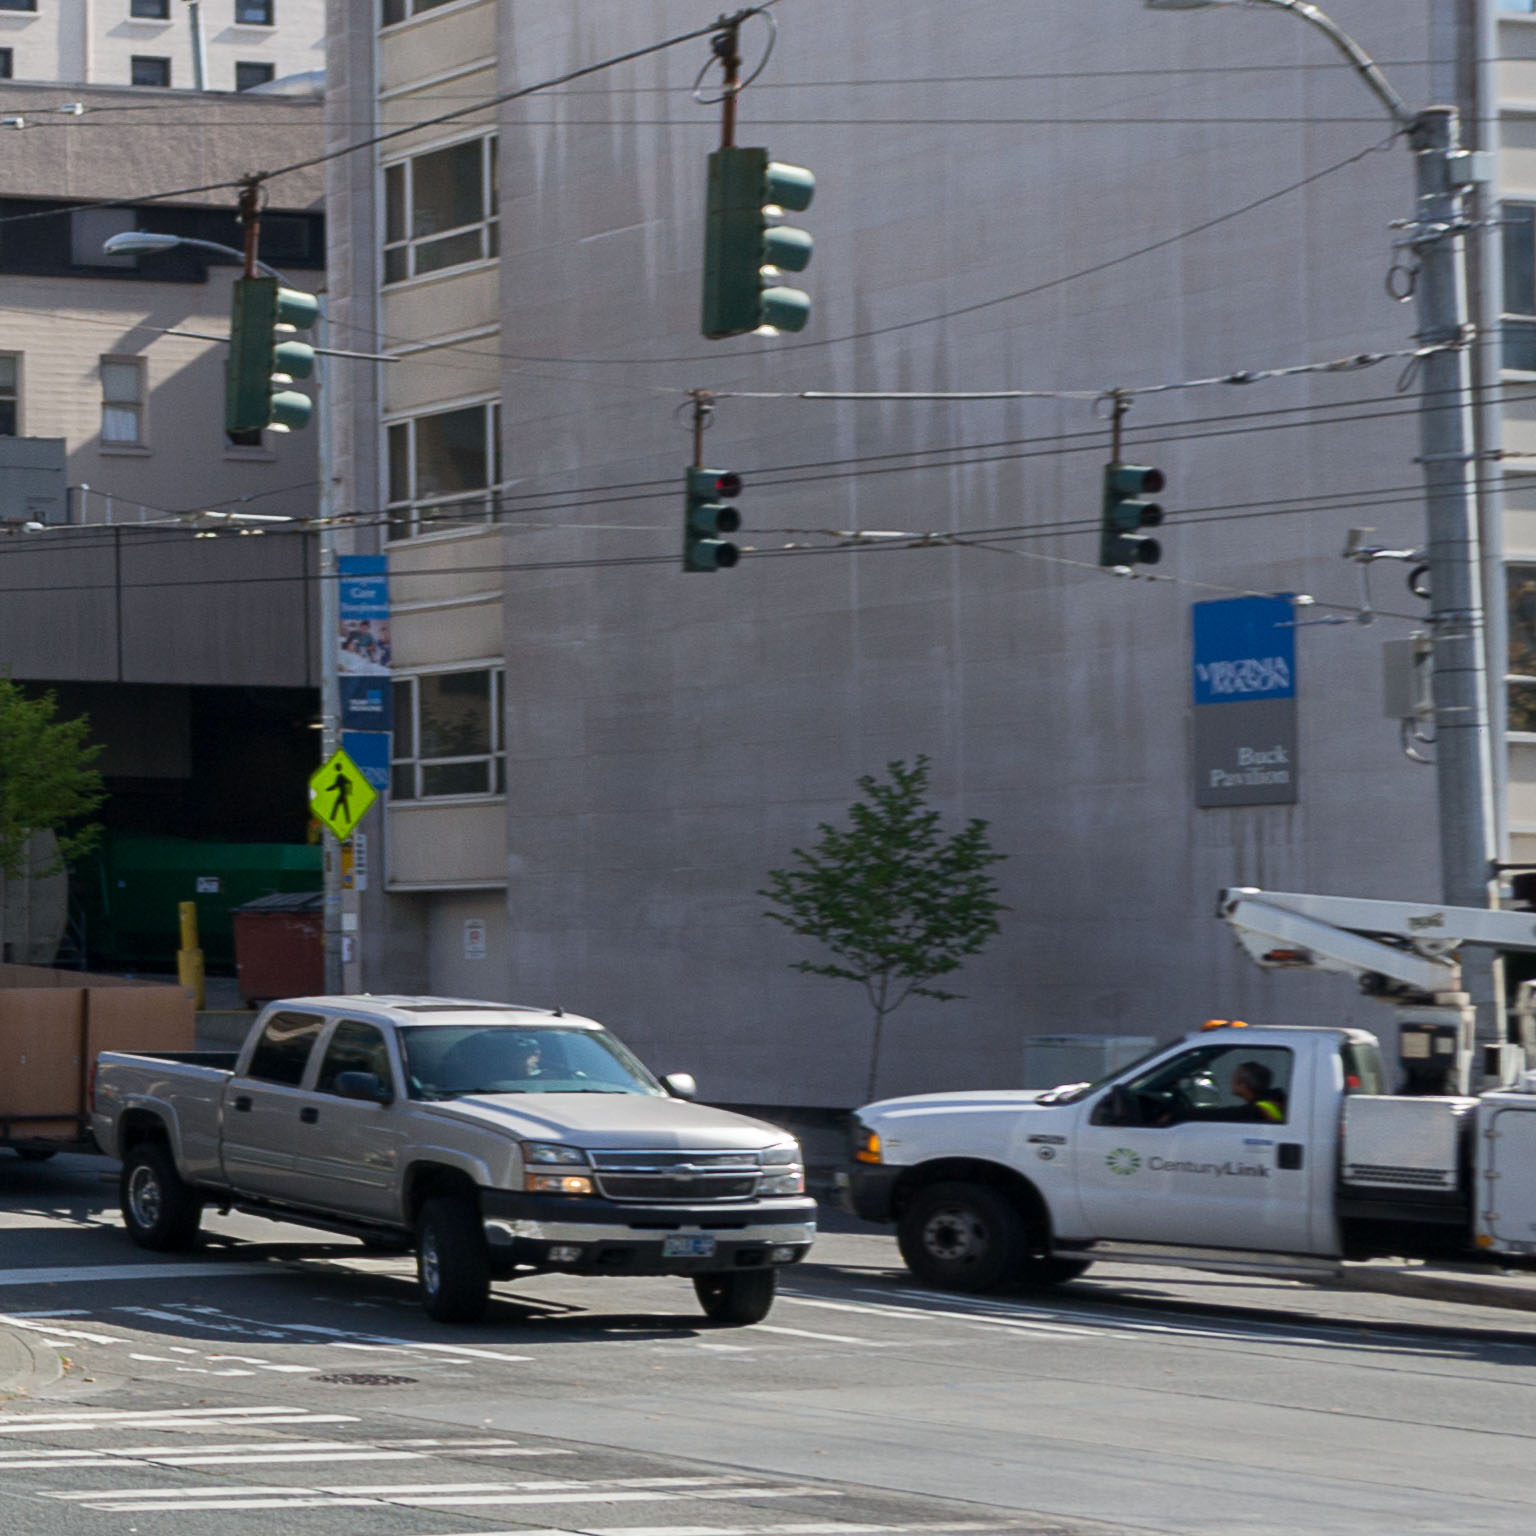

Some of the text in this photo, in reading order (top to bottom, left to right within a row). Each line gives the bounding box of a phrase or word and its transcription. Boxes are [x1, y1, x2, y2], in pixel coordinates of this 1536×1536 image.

[1196, 656, 1289, 682] VIRGINIA
[1210, 671, 1289, 694] MASON
[1238, 744, 1289, 766] Buck
[1209, 767, 1289, 787] Pavilion
[1148, 1156, 1270, 1177] CenturyLink
